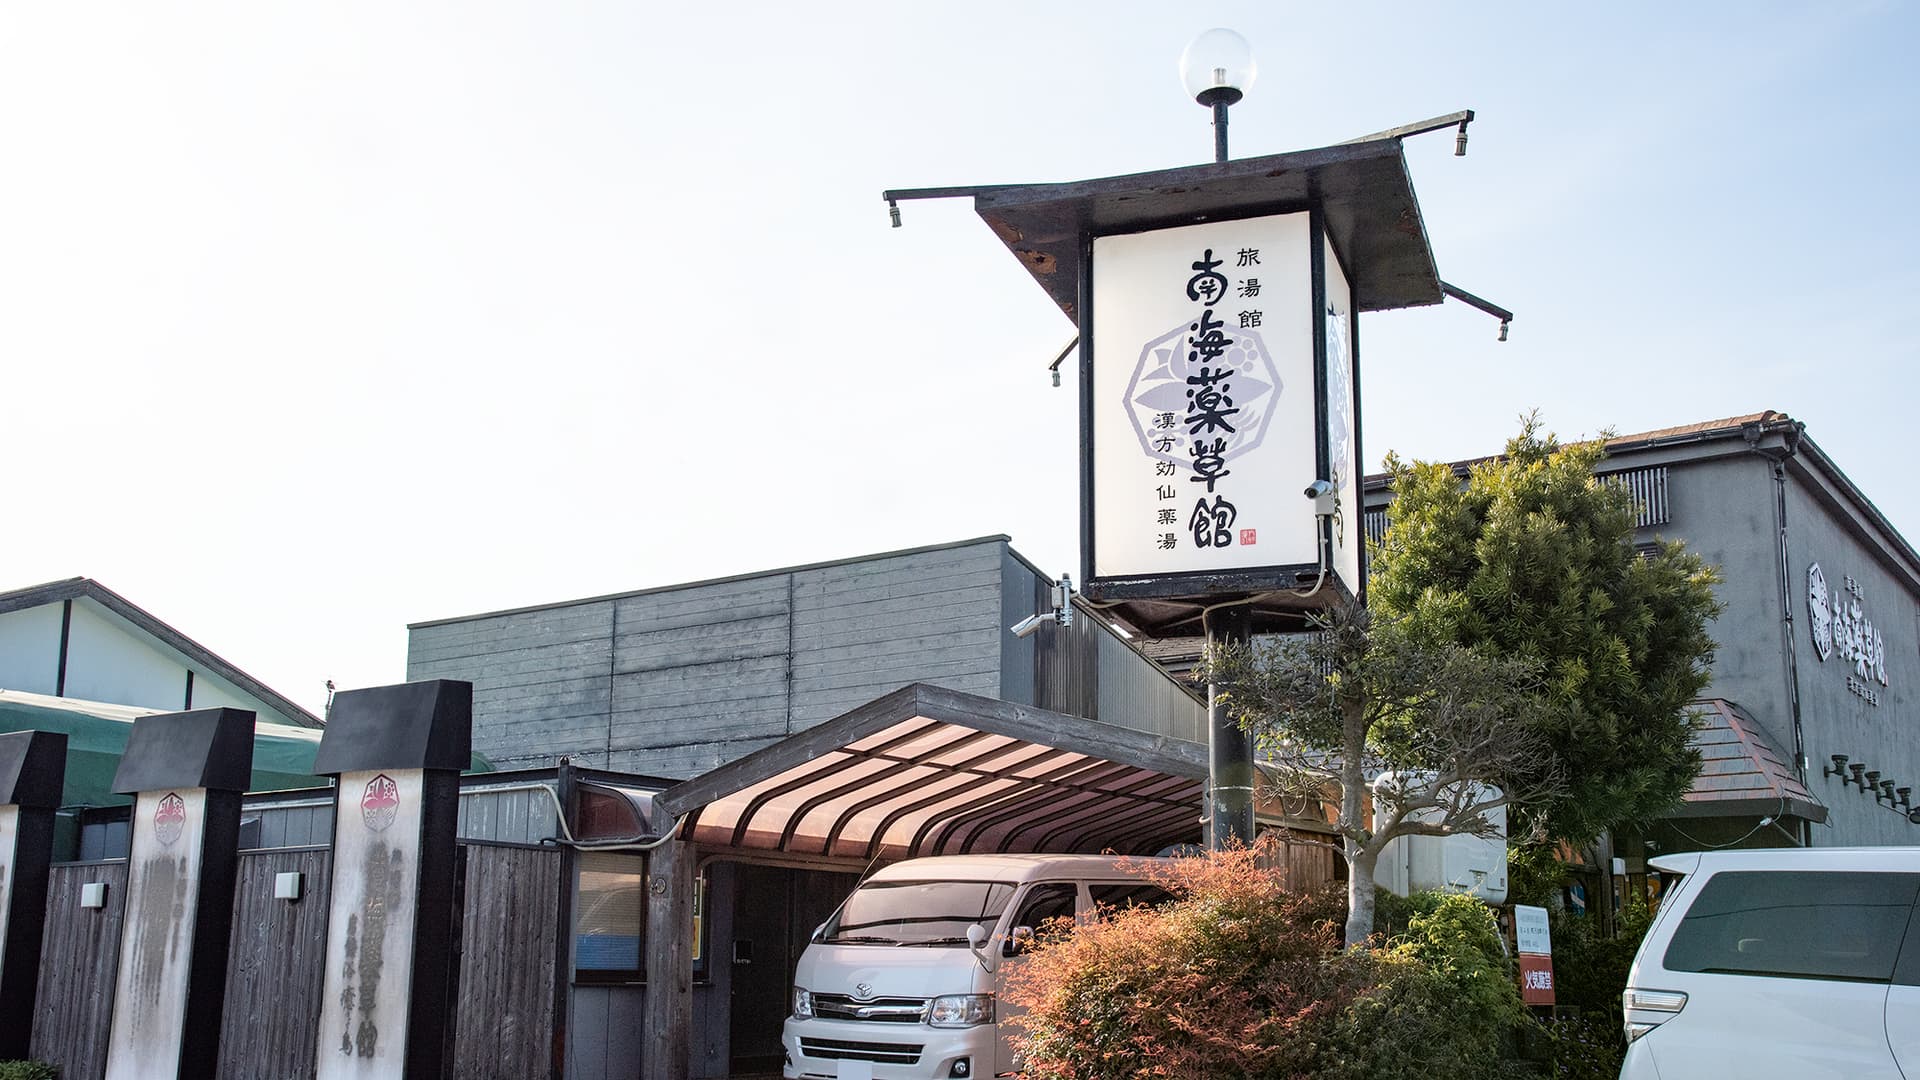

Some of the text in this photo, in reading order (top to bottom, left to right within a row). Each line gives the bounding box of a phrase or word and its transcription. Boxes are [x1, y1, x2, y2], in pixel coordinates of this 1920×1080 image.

[1236, 248, 1262, 329] 旅湯館
[1184, 248, 1239, 549] 南海薬草館
[1155, 412, 1177, 550] 漢方効仙薬湯
[1524, 970, 1553, 990] 火気厳禁
